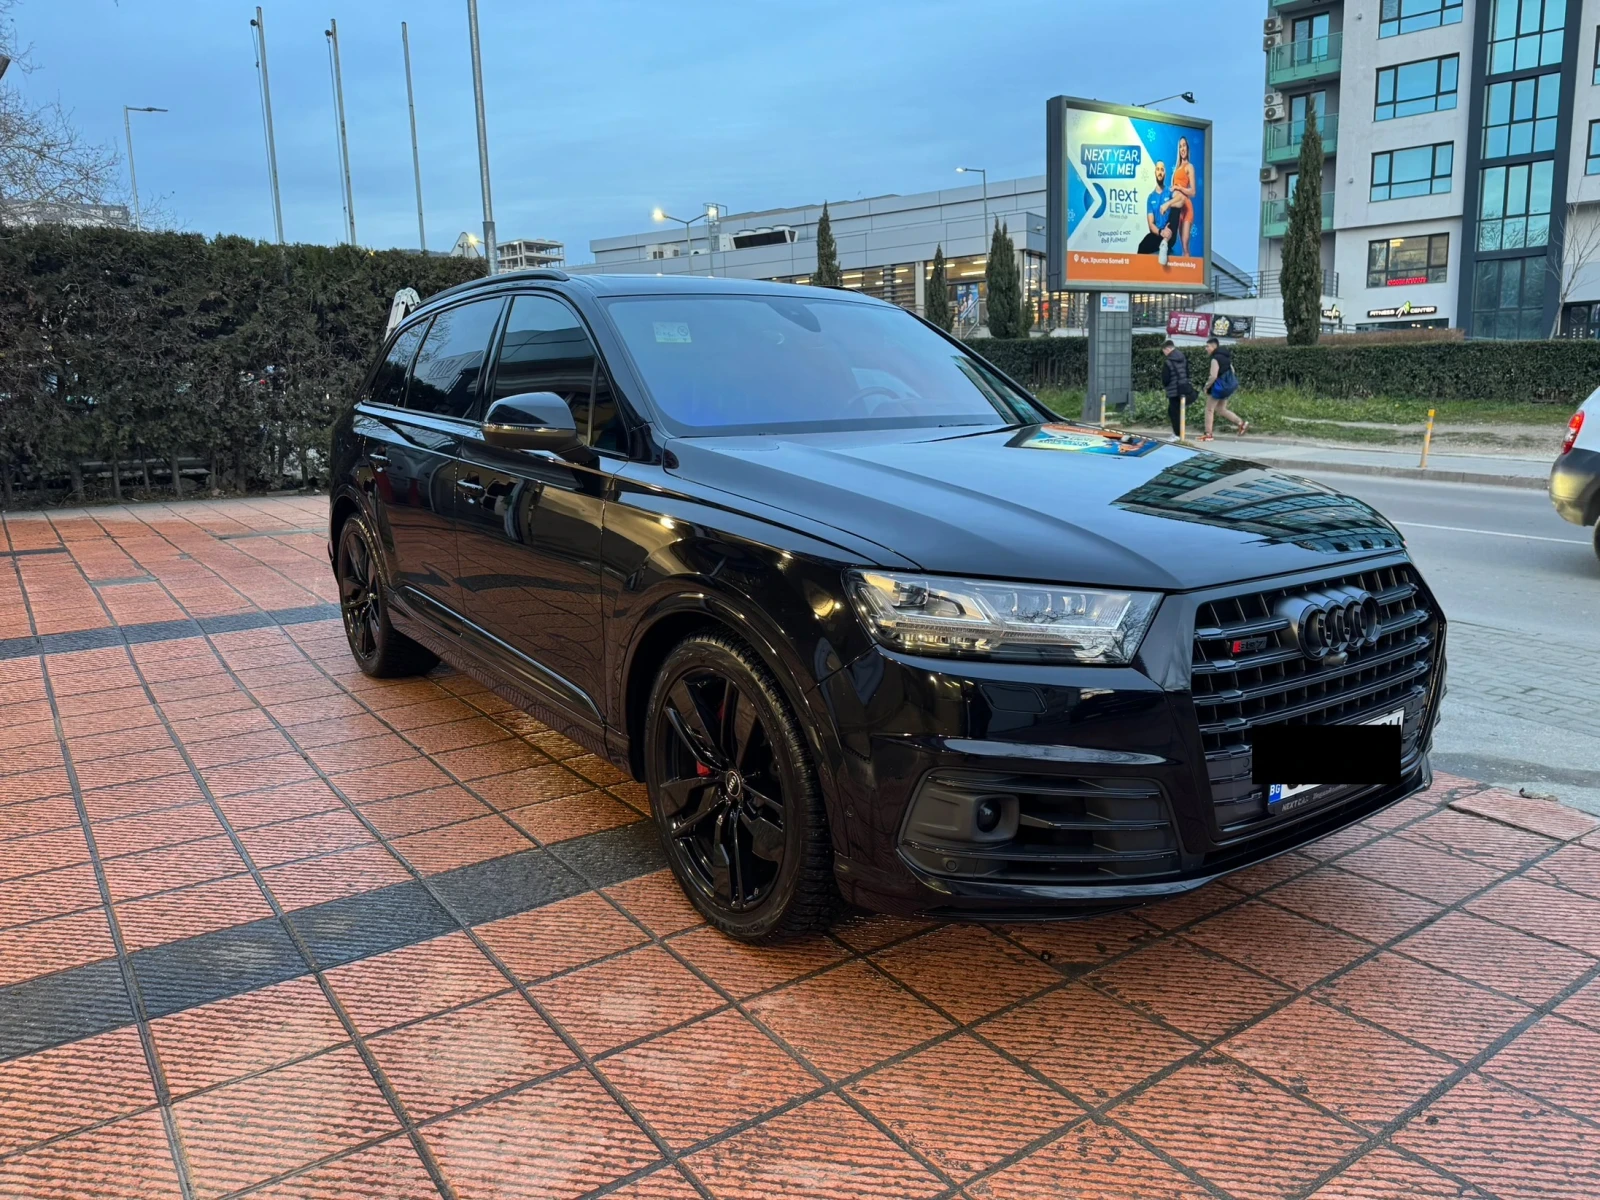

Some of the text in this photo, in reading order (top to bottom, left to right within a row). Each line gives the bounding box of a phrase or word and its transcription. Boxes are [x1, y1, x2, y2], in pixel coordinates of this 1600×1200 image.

[1084, 149, 1140, 163] NEXT YEAR,
[1089, 163, 1134, 175] NEXT ME!
[1110, 187, 1138, 203] next
[1110, 203, 1138, 215] LEVEL
[1410, 306, 1435, 314] CENTER
[1269, 784, 1281, 795] BG
